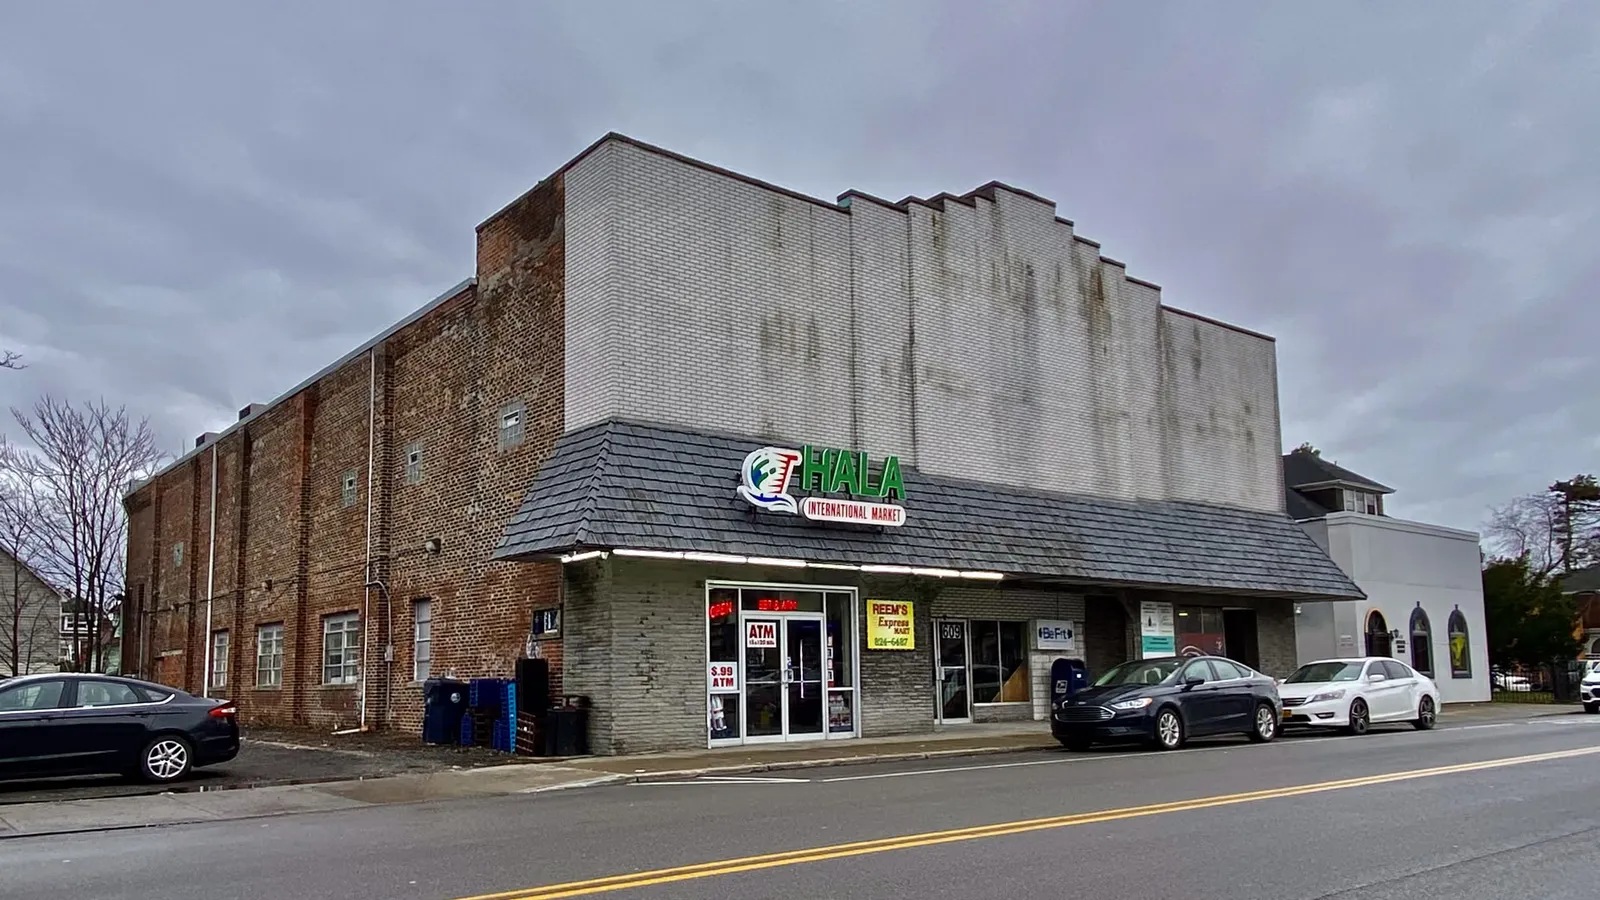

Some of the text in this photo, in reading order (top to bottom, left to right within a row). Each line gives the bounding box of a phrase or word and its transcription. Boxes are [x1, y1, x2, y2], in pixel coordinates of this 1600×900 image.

[802, 445, 906, 500] HALA
[808, 501, 901, 522] INTERNATIONAL MARKET
[872, 603, 908, 615] REEM'S
[878, 616, 909, 629] Express
[749, 624, 774, 639] ATM
[942, 624, 961, 639] 609
[711, 666, 733, 677] $.99
[712, 677, 734, 688] ATM
